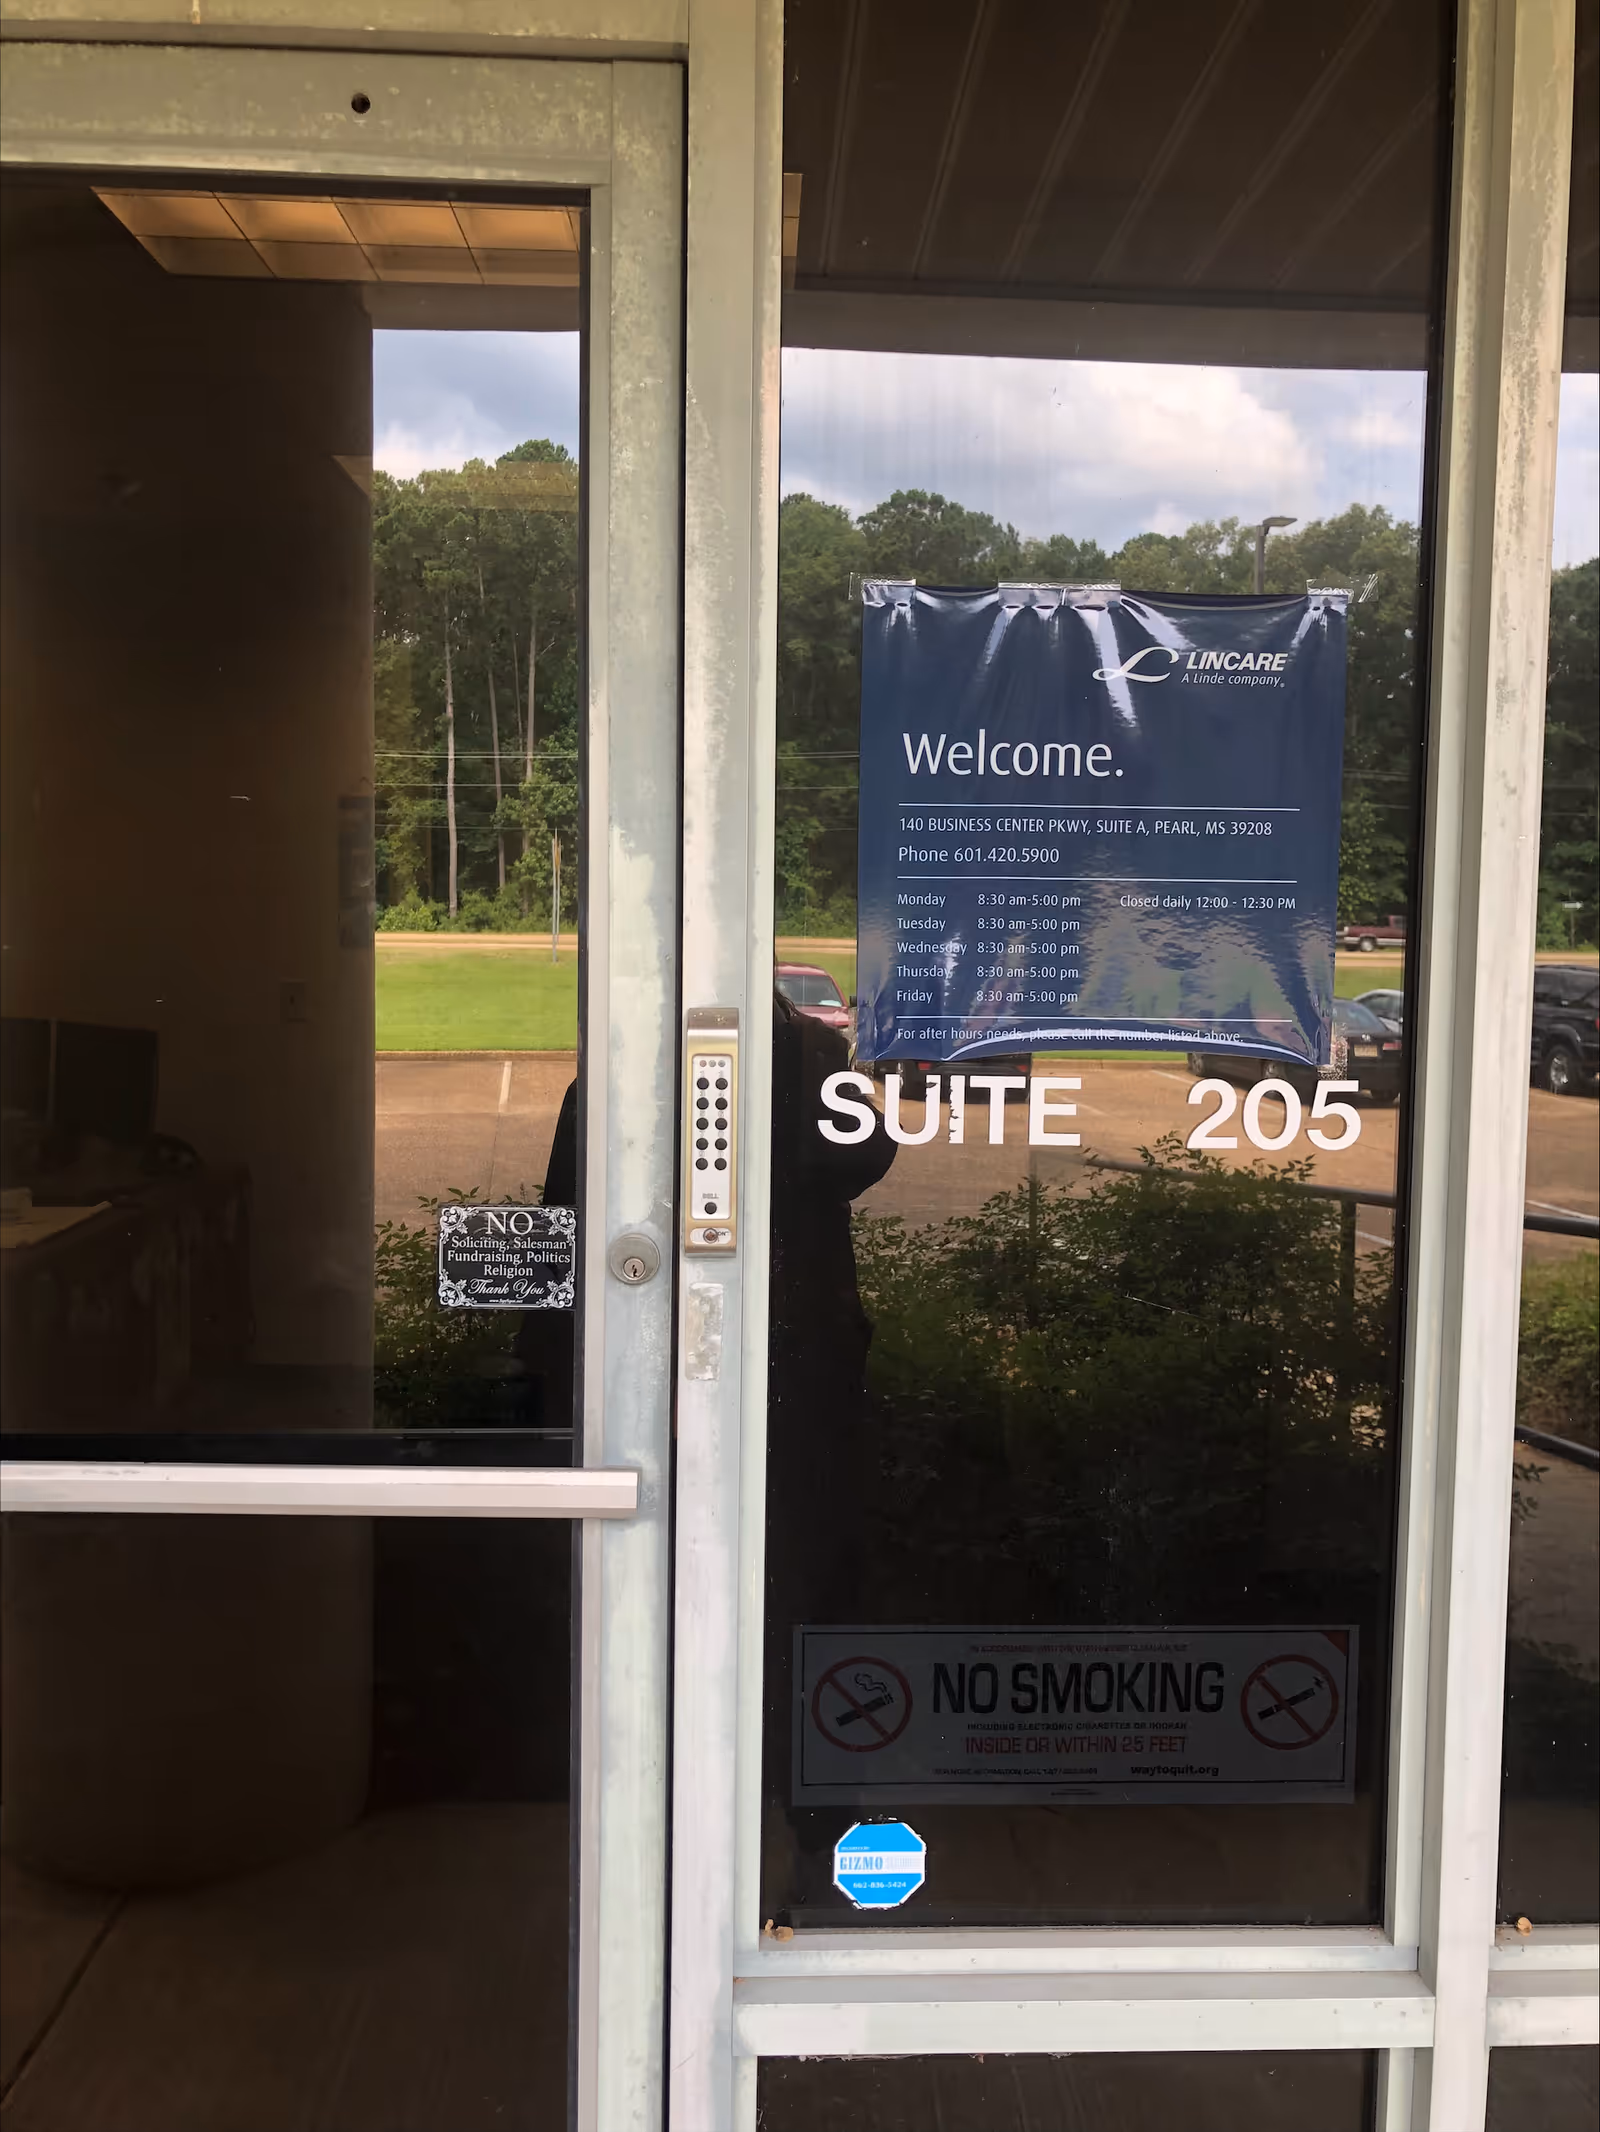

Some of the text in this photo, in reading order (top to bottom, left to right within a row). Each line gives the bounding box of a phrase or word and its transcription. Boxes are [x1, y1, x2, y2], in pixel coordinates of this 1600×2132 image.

[1186, 651, 1289, 671] LINCARE
[1181, 673, 1189, 683] A
[1193, 673, 1225, 684] Linde
[902, 729, 1124, 777] Welcome.
[899, 817, 1272, 837] 140 BUSINESS CENTER PKWY, SUITE A, PEARL, MS 39208
[898, 845, 1060, 863] Phone 601.420.5900
[897, 892, 946, 907] Monday
[977, 893, 1006, 906] 8:30
[1008, 894, 1058, 906] am-5:00
[1062, 897, 1081, 909] pm
[1120, 895, 1159, 908] Closed
[1162, 895, 1192, 911] daily
[1196, 896, 1228, 909] 12:00
[1241, 897, 1274, 909] 12:30
[1277, 898, 1296, 909] PM
[897, 917, 1080, 933] Tuesday 8:30 am-5:00 pm
[897, 941, 1080, 957] Wednesday 8:30 am-5:00 pm
[896, 965, 1079, 981] Thursday 8:30 am-5:00 pm
[896, 989, 1078, 1005] Friday 8:30 am-5:00 pm
[897, 1027, 1244, 1043] For after hours needs, please call the number listed above.
[817, 1071, 1362, 1151] SUITE 205
[484, 1211, 534, 1235] NO
[451, 1236, 567, 1252] Soliciting, Salesman
[447, 1250, 571, 1265] Fundraising, Politics
[484, 1264, 534, 1279] Religion
[467, 1278, 546, 1299] Thank You
[932, 1661, 1225, 1714] NO SMOKING
[965, 1736, 1187, 1754] INSIDE OR WITHIN 25 FEET
[1130, 1764, 1220, 1777] waytoquit.org
[839, 1856, 883, 1870] GIZMO
